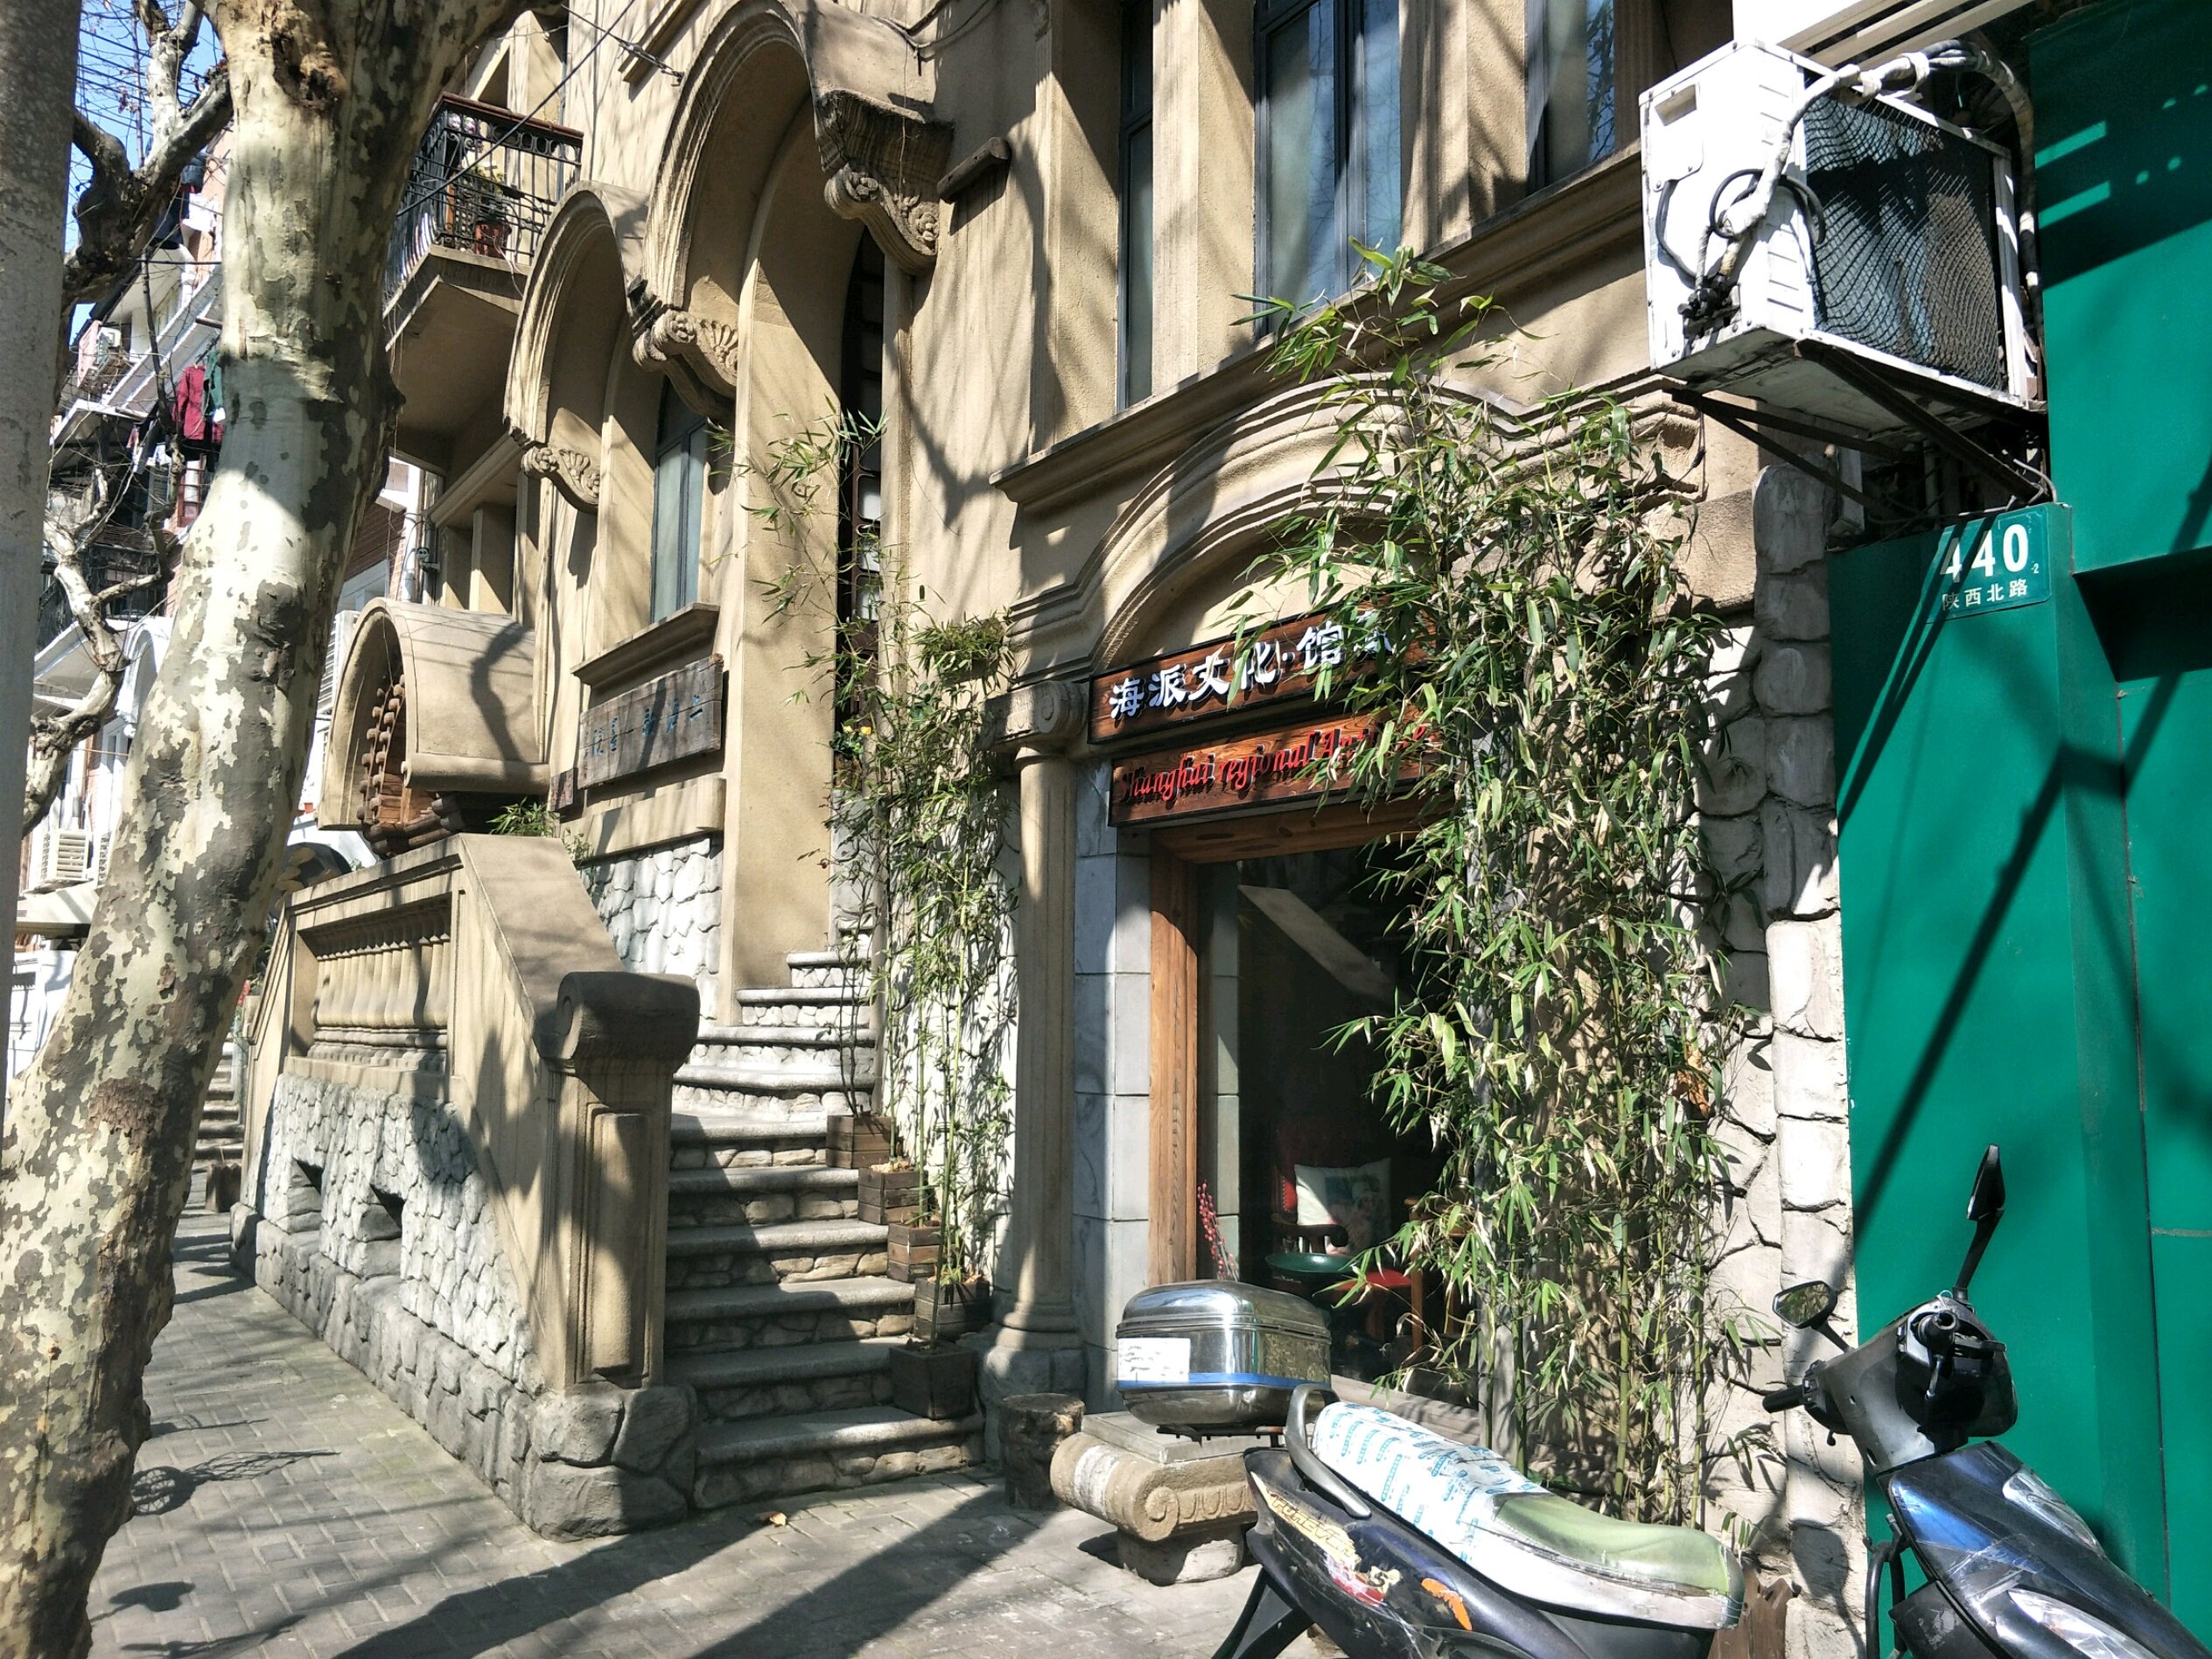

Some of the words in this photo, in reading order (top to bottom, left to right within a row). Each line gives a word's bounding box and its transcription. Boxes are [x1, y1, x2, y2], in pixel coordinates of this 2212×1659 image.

[1940, 524, 2028, 583] 440
[1942, 578, 2027, 611] 陕西北路
[1119, 752, 1214, 802] Shanghai
[1218, 730, 1321, 791] regional
